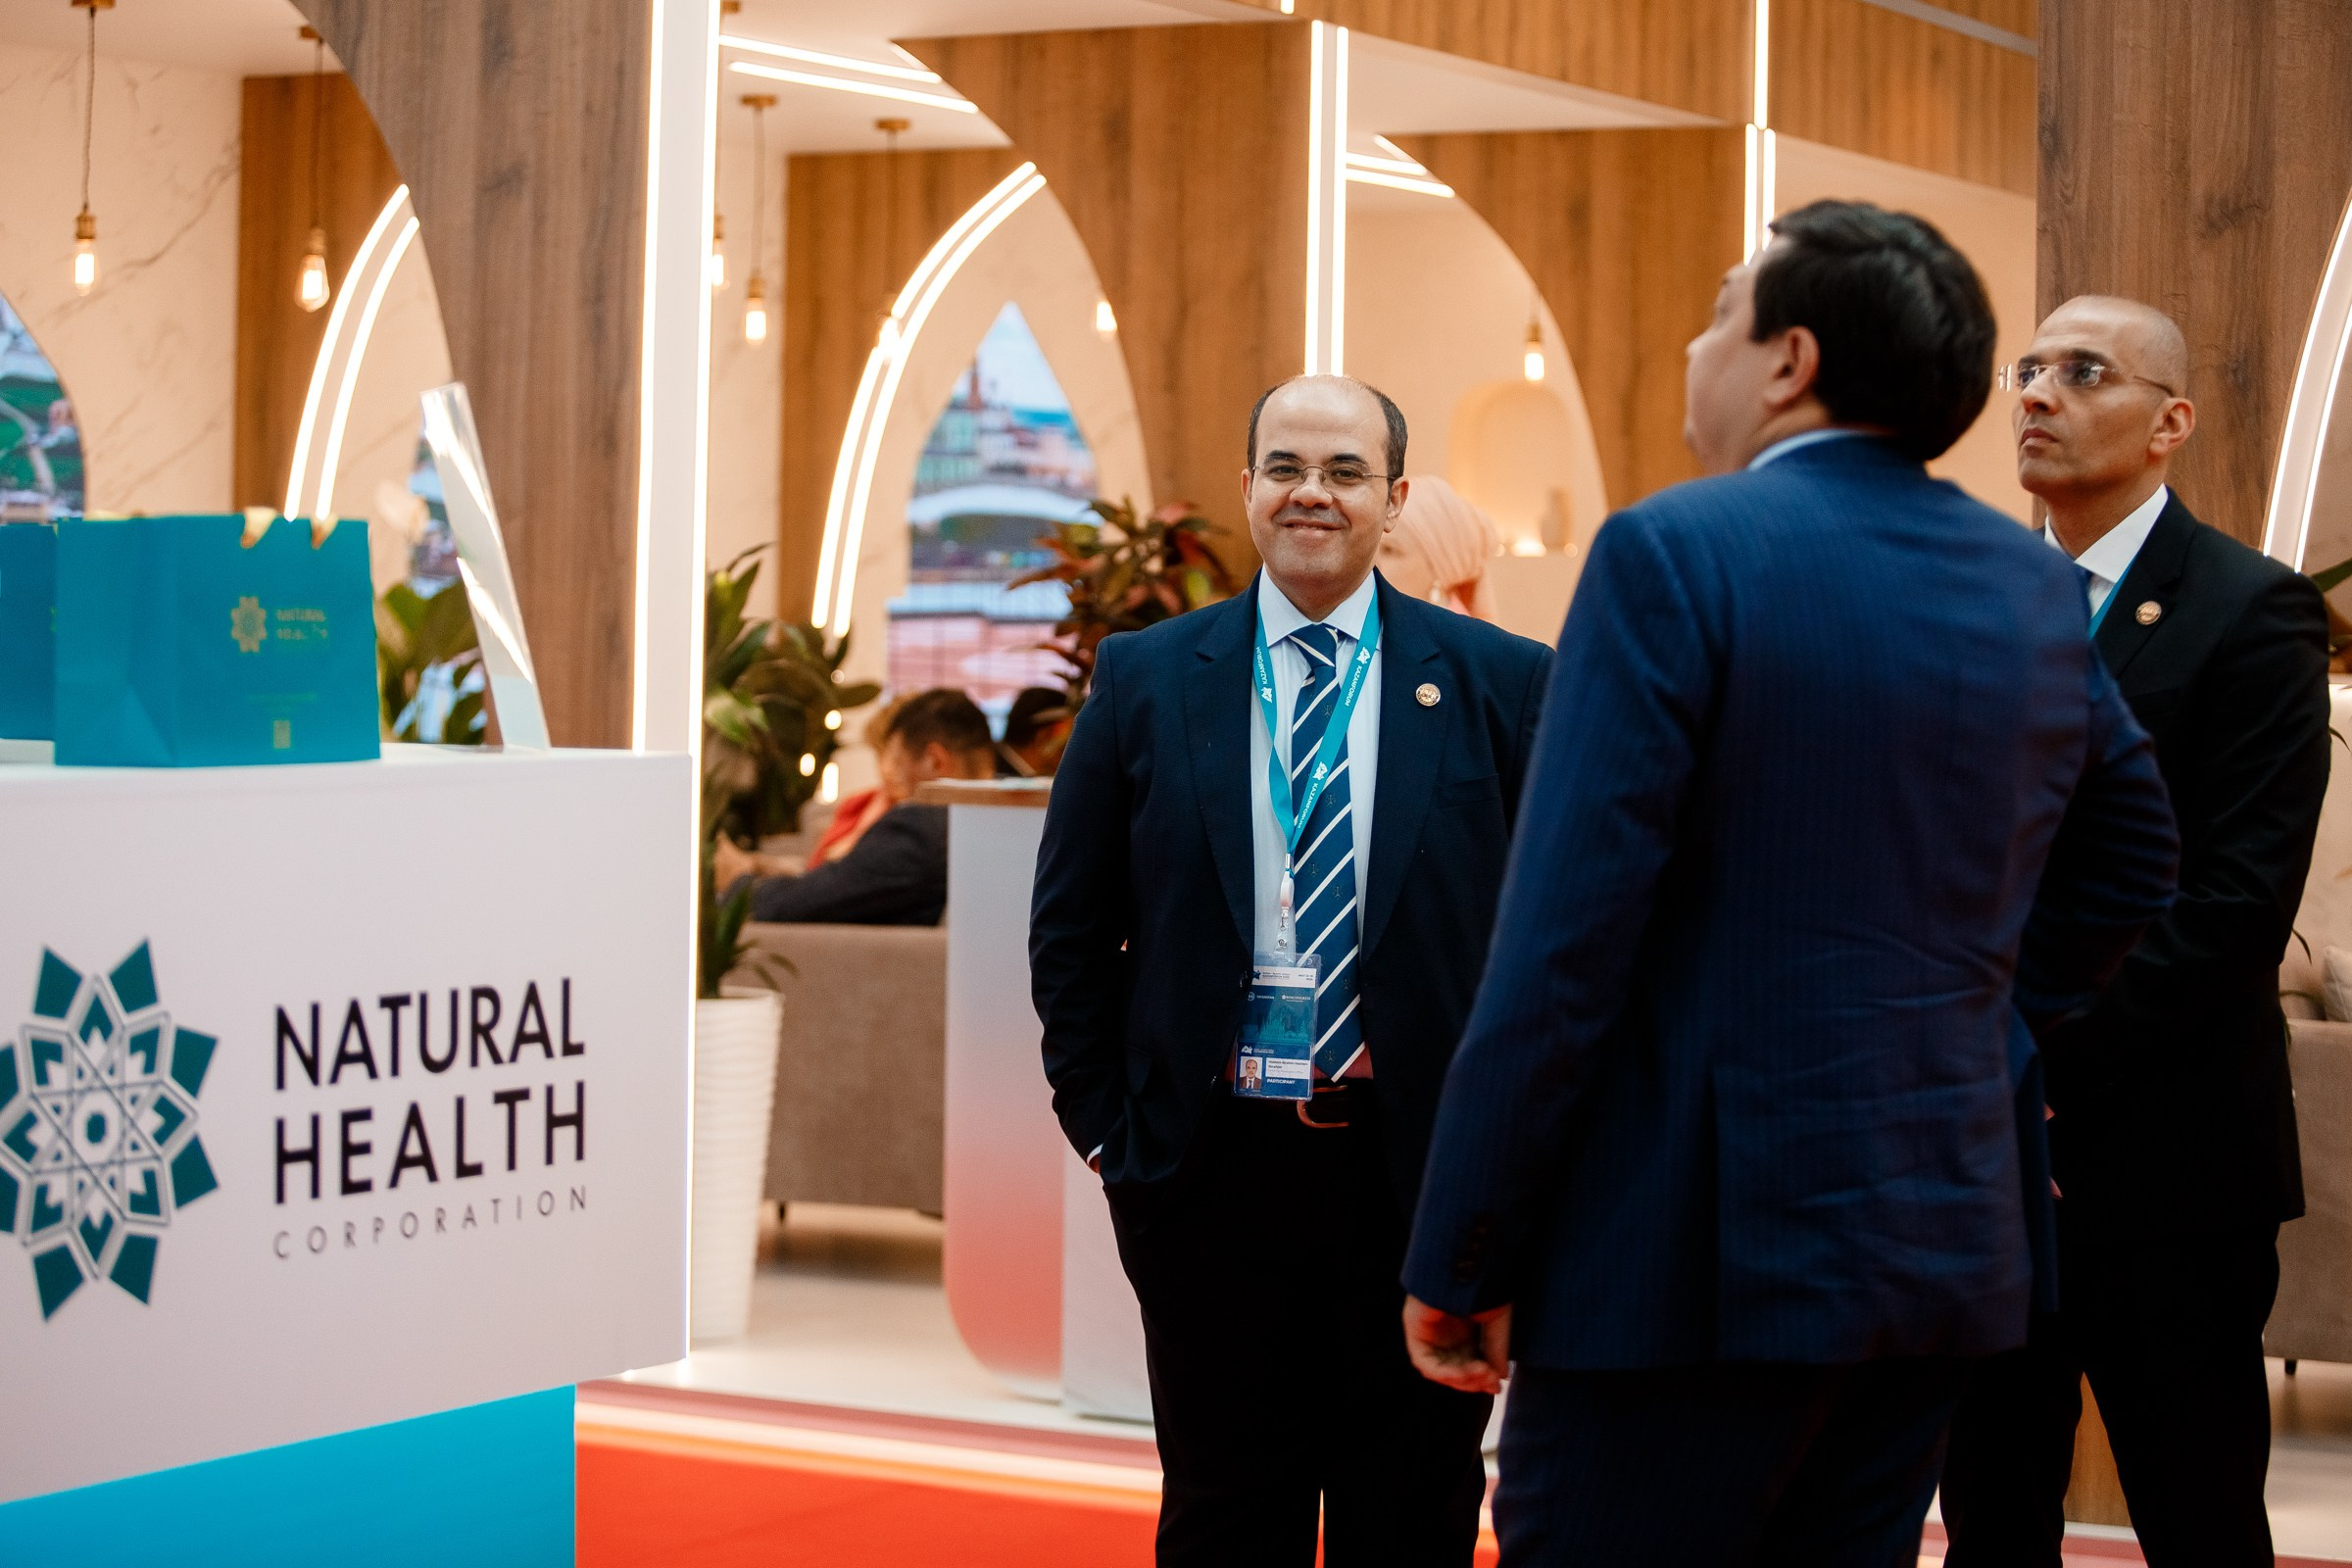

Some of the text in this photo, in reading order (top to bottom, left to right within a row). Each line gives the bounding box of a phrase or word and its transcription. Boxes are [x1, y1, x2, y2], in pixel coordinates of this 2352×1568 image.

[275, 626, 328, 640] HEAH
[1254, 646, 1268, 685] KAZANFORUM
[1344, 665, 1363, 707] KAZANFORUM
[1298, 783, 1319, 829] KAZANFORUM
[273, 977, 586, 1092] NATURAL
[273, 1080, 587, 1206] HEALTH
[272, 1185, 589, 1260] CORPORATION
